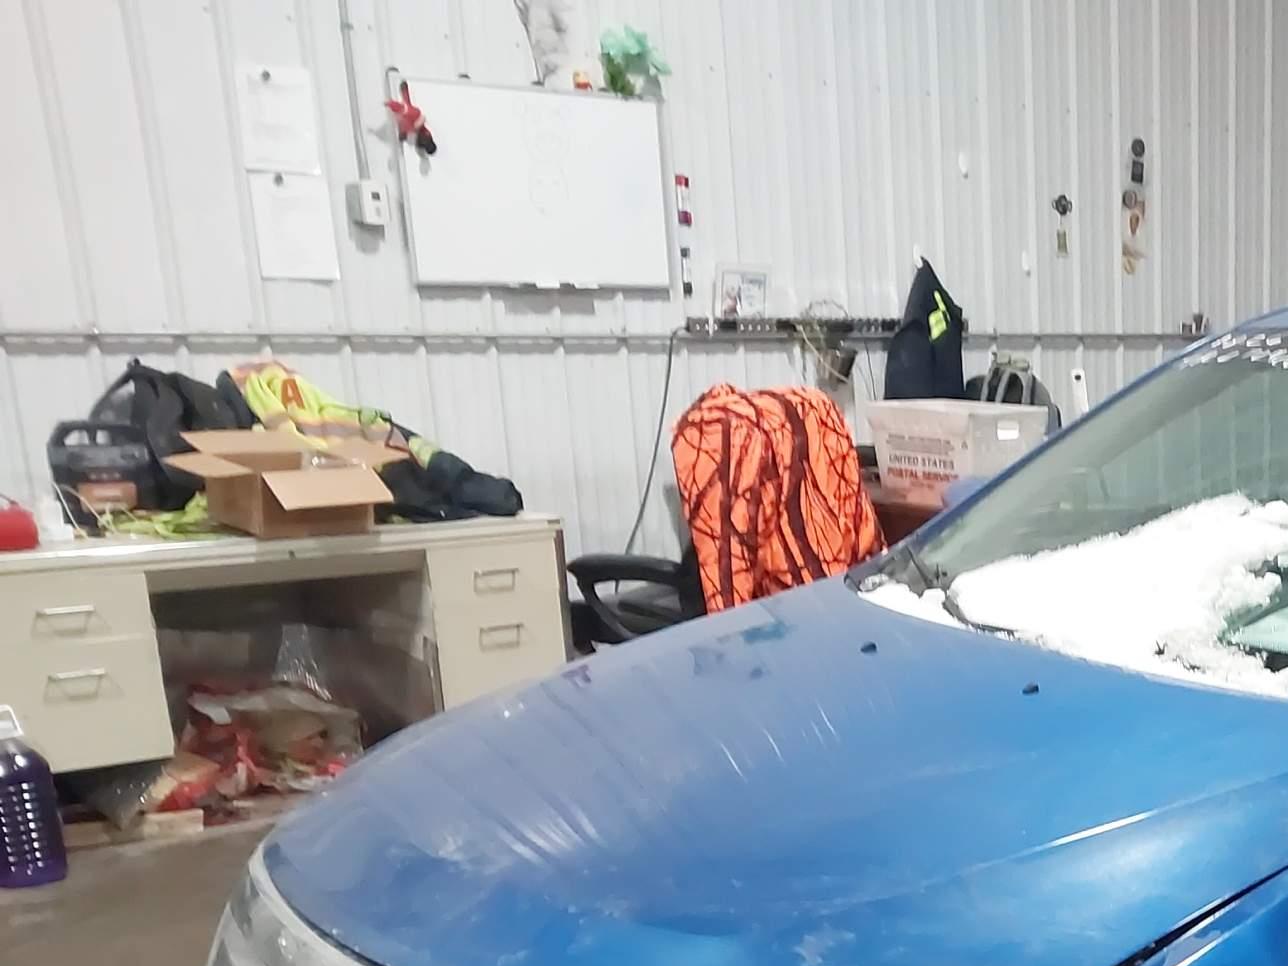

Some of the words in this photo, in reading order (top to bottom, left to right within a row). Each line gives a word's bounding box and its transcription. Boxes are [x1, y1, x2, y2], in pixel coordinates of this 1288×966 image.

[281, 378, 305, 410] A
[887, 453, 919, 466] UNITED
[921, 458, 954, 470] STATES
